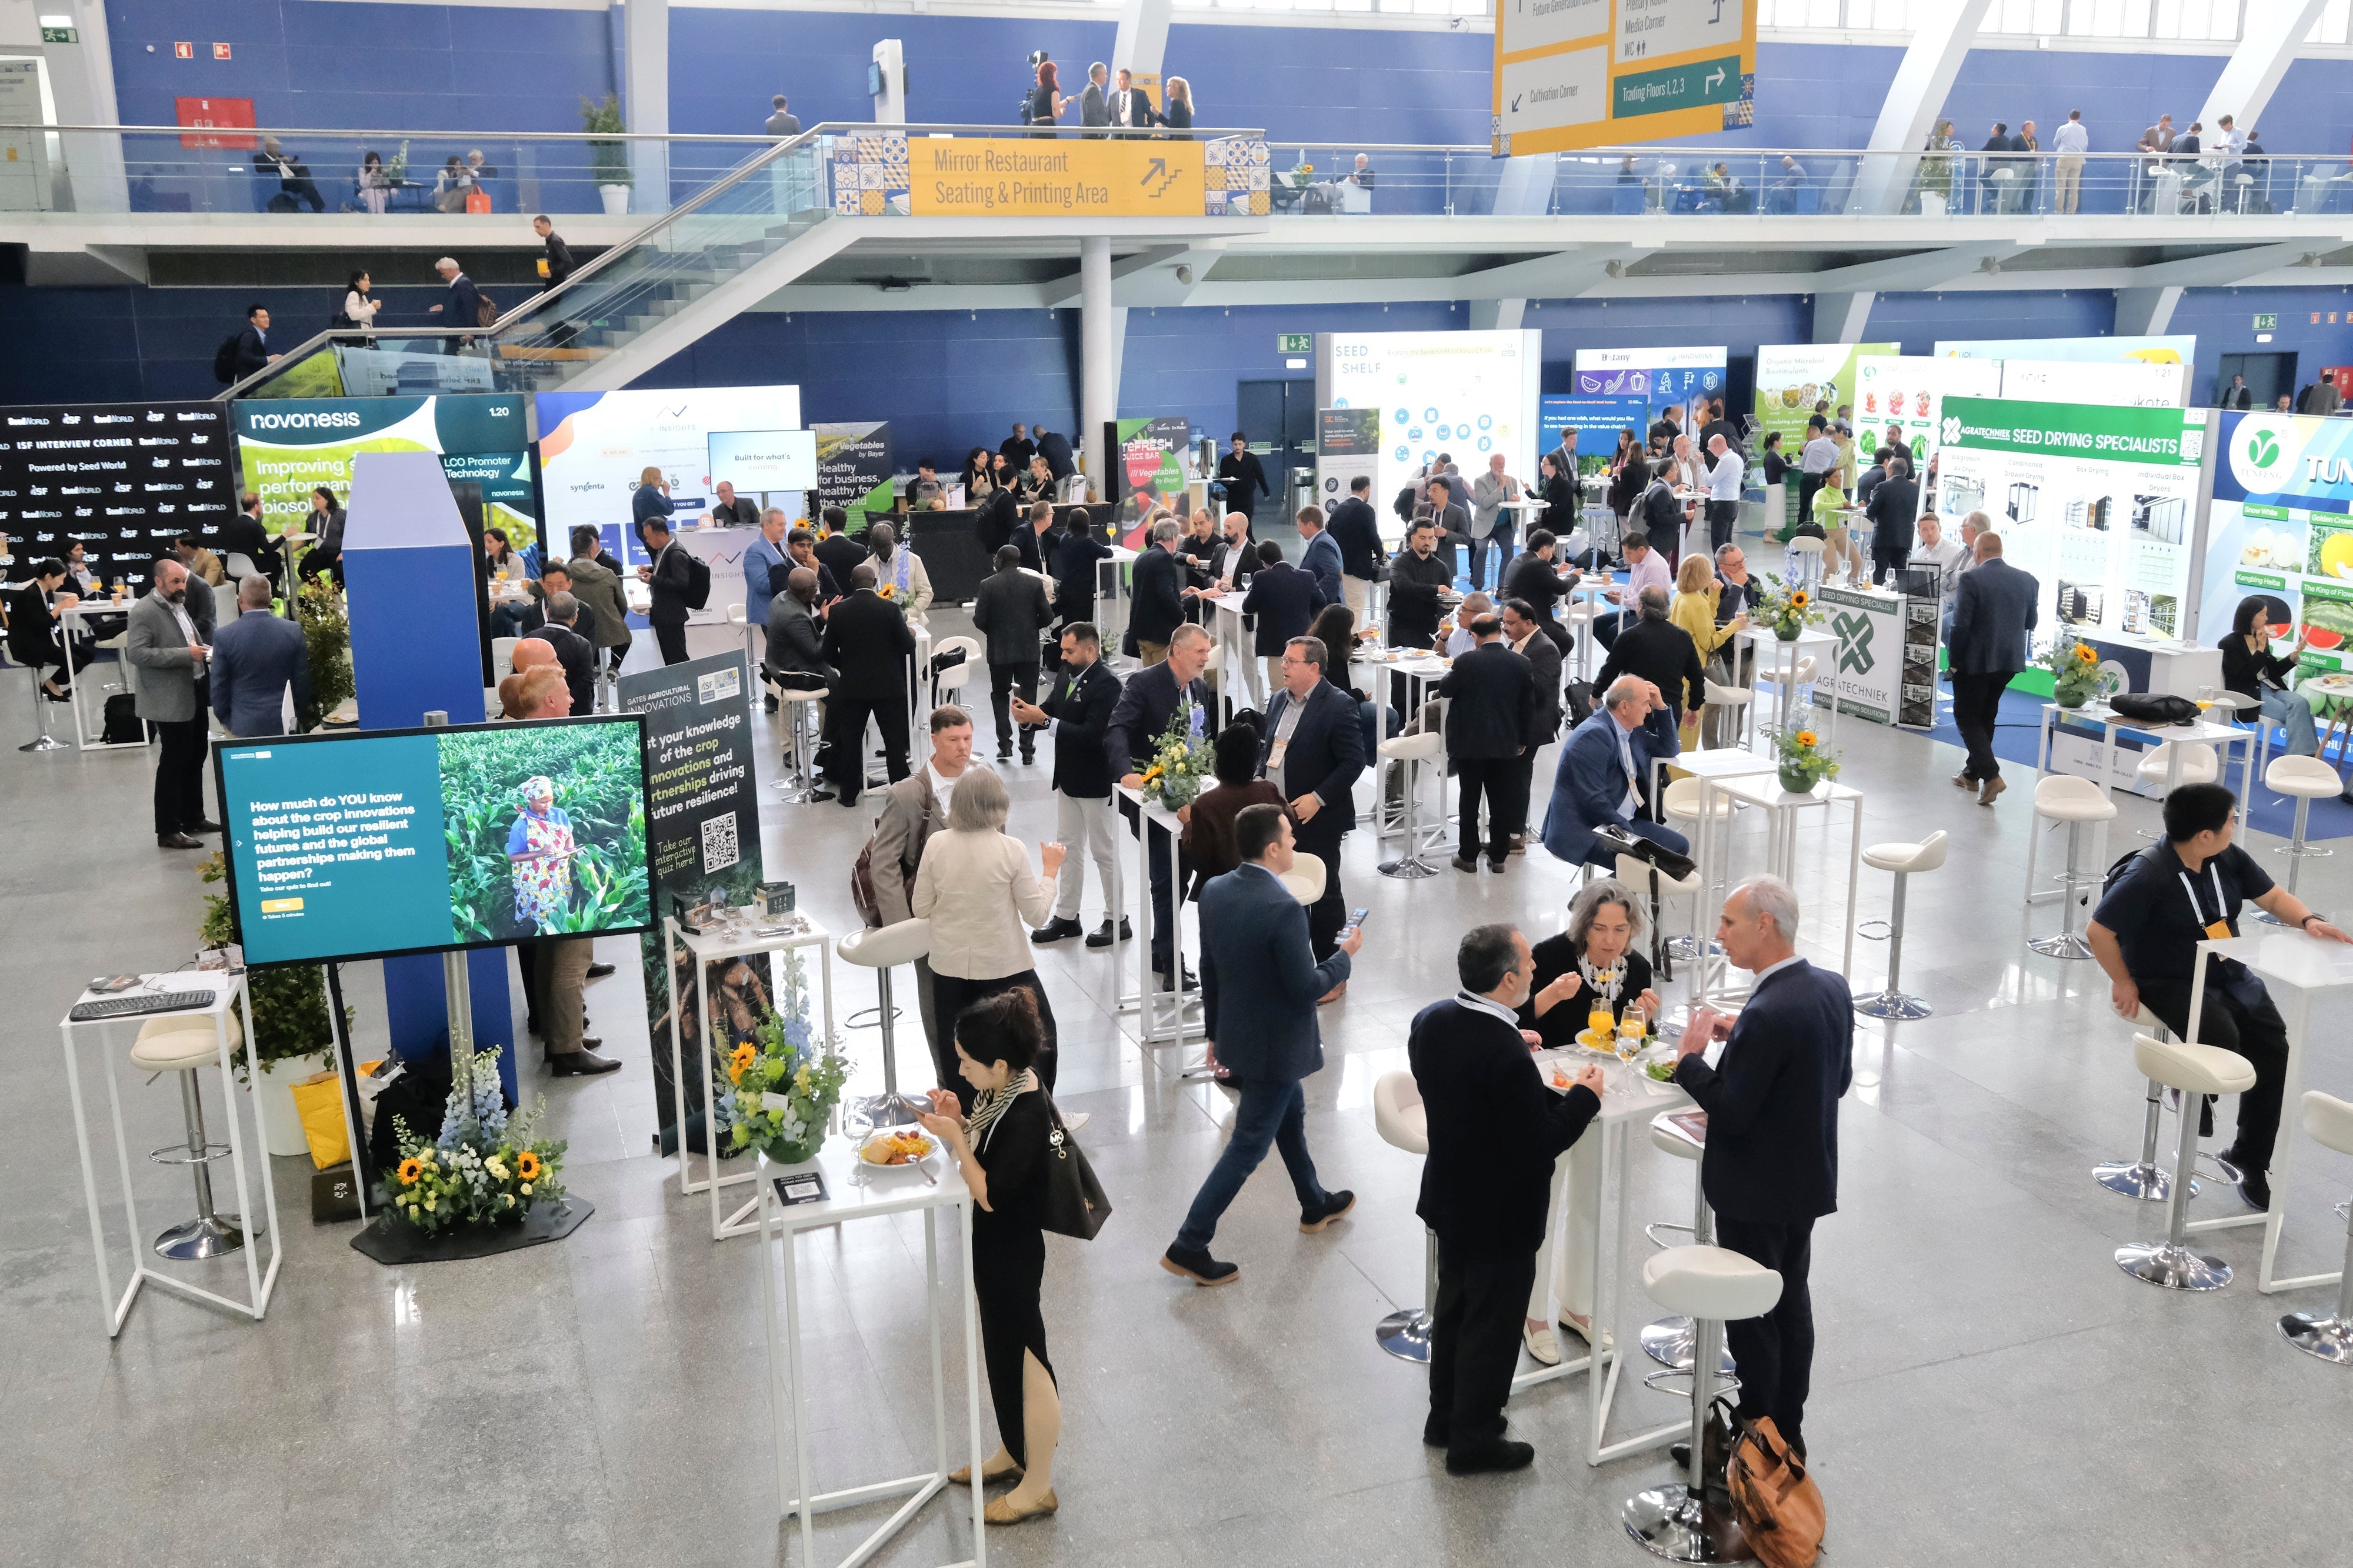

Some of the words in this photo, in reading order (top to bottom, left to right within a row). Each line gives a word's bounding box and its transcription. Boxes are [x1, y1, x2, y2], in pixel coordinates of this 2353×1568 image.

[1532, 3, 1550, 16] Future
[1625, 19, 1644, 34] Media
[1645, 15, 1665, 31] Corner
[1624, 42, 1634, 56] WC
[1530, 87, 1559, 104] Cultivation
[1560, 84, 1578, 100] Corner
[1623, 85, 1645, 102] Trading
[1647, 81, 1665, 98] Floors
[1667, 80, 1671, 95] 1,
[1672, 79, 1679, 94] 2,
[1680, 78, 1685, 92] 3
[934, 149, 982, 172] Mirror
[985, 150, 1068, 172] Restaurant
[935, 181, 994, 208] Seating
[998, 182, 1009, 204] &
[1013, 182, 1072, 208] Printing
[1076, 182, 1108, 204] Area
[1336, 345, 1368, 356] SEED
[1342, 363, 1381, 373] SHELF
[1766, 358, 1792, 366] Organic
[489, 406, 510, 417] 1.20
[251, 411, 361, 429] novonesis
[16, 441, 33, 449] ISF
[36, 439, 91, 449] INTERVIEW
[93, 438, 133, 448] CORNER
[839, 441, 885, 452] Vegetables
[1122, 438, 1173, 452] reFRESH
[1960, 426, 2011, 438] AGRATECHNIEK
[2012, 428, 2042, 445] SEED
[2045, 431, 2092, 449] DRYING
[2095, 434, 2178, 455] SPECIALISTS
[444, 457, 465, 468] LCO
[468, 456, 511, 467] Promoter
[1122, 452, 1144, 461] JUICE
[2008, 459, 2043, 468] Conditioned
[29, 463, 65, 472] Powered
[67, 463, 78, 472] by
[79, 462, 99, 471] Seed
[101, 461, 126, 470] World
[256, 458, 344, 478] Improving
[445, 468, 499, 479] Technology
[817, 462, 856, 474] Healthy
[1139, 468, 1179, 478] Vegetables
[2088, 467, 2109, 476] Drying
[818, 475, 832, 484] for
[835, 474, 881, 484] business,
[2025, 472, 2045, 482] Drying
[2138, 471, 2171, 480] Individual
[259, 479, 353, 498] performan
[491, 489, 525, 498] novonesis
[570, 483, 605, 493] syngenta
[818, 485, 856, 497] healthy
[858, 485, 872, 494] for
[2149, 484, 2171, 492] Dryers
[819, 498, 835, 508] the
[838, 496, 867, 507] world
[2244, 506, 2261, 514] Snow
[2261, 508, 2278, 516] White
[2311, 514, 2332, 523] Golden
[2237, 573, 2263, 584] Kangbing
[2264, 578, 2281, 586] Heiba
[2304, 584, 2315, 592] The
[2315, 586, 2329, 595] King
[1821, 590, 1836, 600] SEED
[1837, 593, 1859, 605] DRYING
[1861, 598, 1895, 612] SPECIALIST
[2310, 656, 2327, 665] Bead
[627, 695, 646, 705] GATES
[648, 684, 691, 700] AGRICULTURAL
[628, 692, 692, 713] INNOVATIONS
[1842, 702, 1860, 712] DRYING
[1861, 706, 1888, 720] SOLUTIONS
[658, 728, 684, 750] your
[686, 713, 741, 739] knowledge
[660, 750, 672, 763] of
[675, 744, 693, 759] the
[695, 739, 719, 756] crop
[713, 749, 733, 766] and
[651, 776, 707, 803] rtnerships
[709, 764, 745, 784] driving
[250, 801, 279, 812] How
[282, 797, 317, 810] much
[319, 796, 337, 808] do
[337, 794, 367, 806] YOU
[369, 792, 403, 804] know
[651, 801, 684, 821] uture
[685, 781, 738, 809] resilience!
[252, 814, 289, 827] about
[291, 811, 311, 823] the
[313, 810, 342, 823] crop
[344, 805, 415, 819] innovations
[253, 828, 301, 842] helping
[302, 825, 334, 838] build
[336, 823, 358, 833] our
[360, 819, 409, 832] resilient
[255, 842, 300, 854] futures
[302, 839, 326, 850] and
[327, 837, 348, 849] the
[350, 833, 388, 849] global
[657, 839, 676, 855] Take
[678, 836, 692, 849] our
[256, 852, 335, 870] partnerships
[337, 849, 382, 862] making
[384, 846, 415, 858] them
[655, 845, 696, 866] interactive
[657, 861, 674, 880] quiz
[676, 855, 696, 871] here!
[258, 867, 313, 883] happen?
